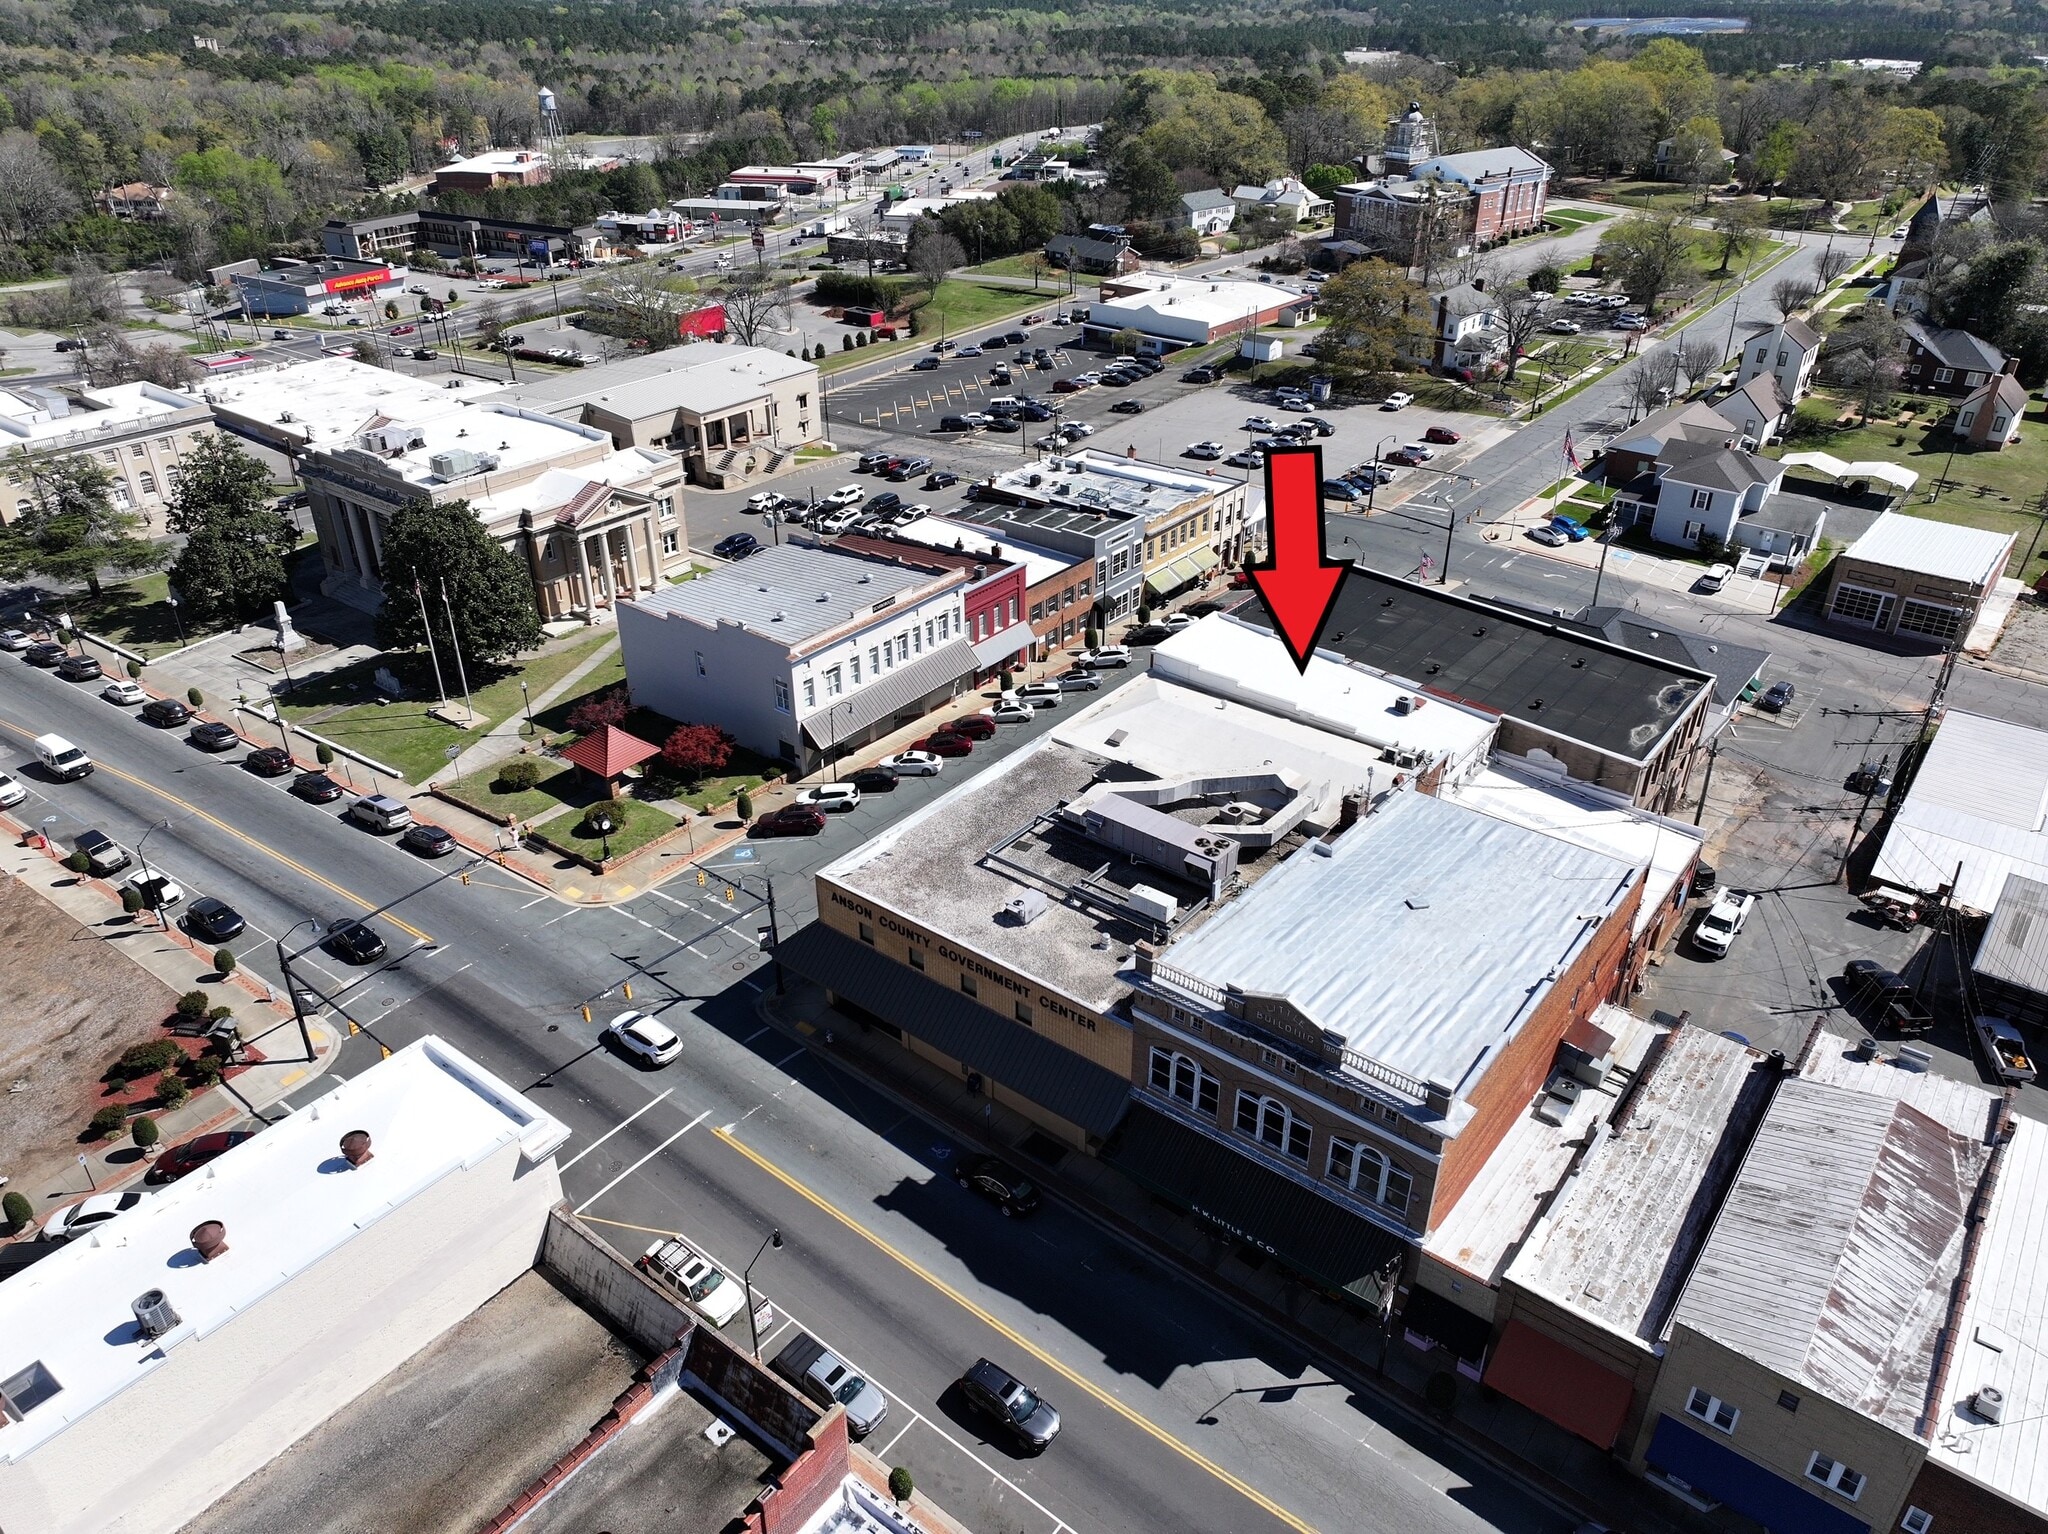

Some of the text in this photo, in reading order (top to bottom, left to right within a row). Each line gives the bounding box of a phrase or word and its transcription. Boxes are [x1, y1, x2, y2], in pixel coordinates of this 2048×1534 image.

[831, 892, 1096, 1032] ANSON COUNTY GOVERNMENT CENTER
[1256, 1011, 1314, 1044] BUILDING
[1192, 1204, 1200, 1213] H.
[1202, 1209, 1210, 1219] W.
[1213, 1216, 1242, 1235] LITTLE
[1257, 1241, 1278, 1256] CO.
